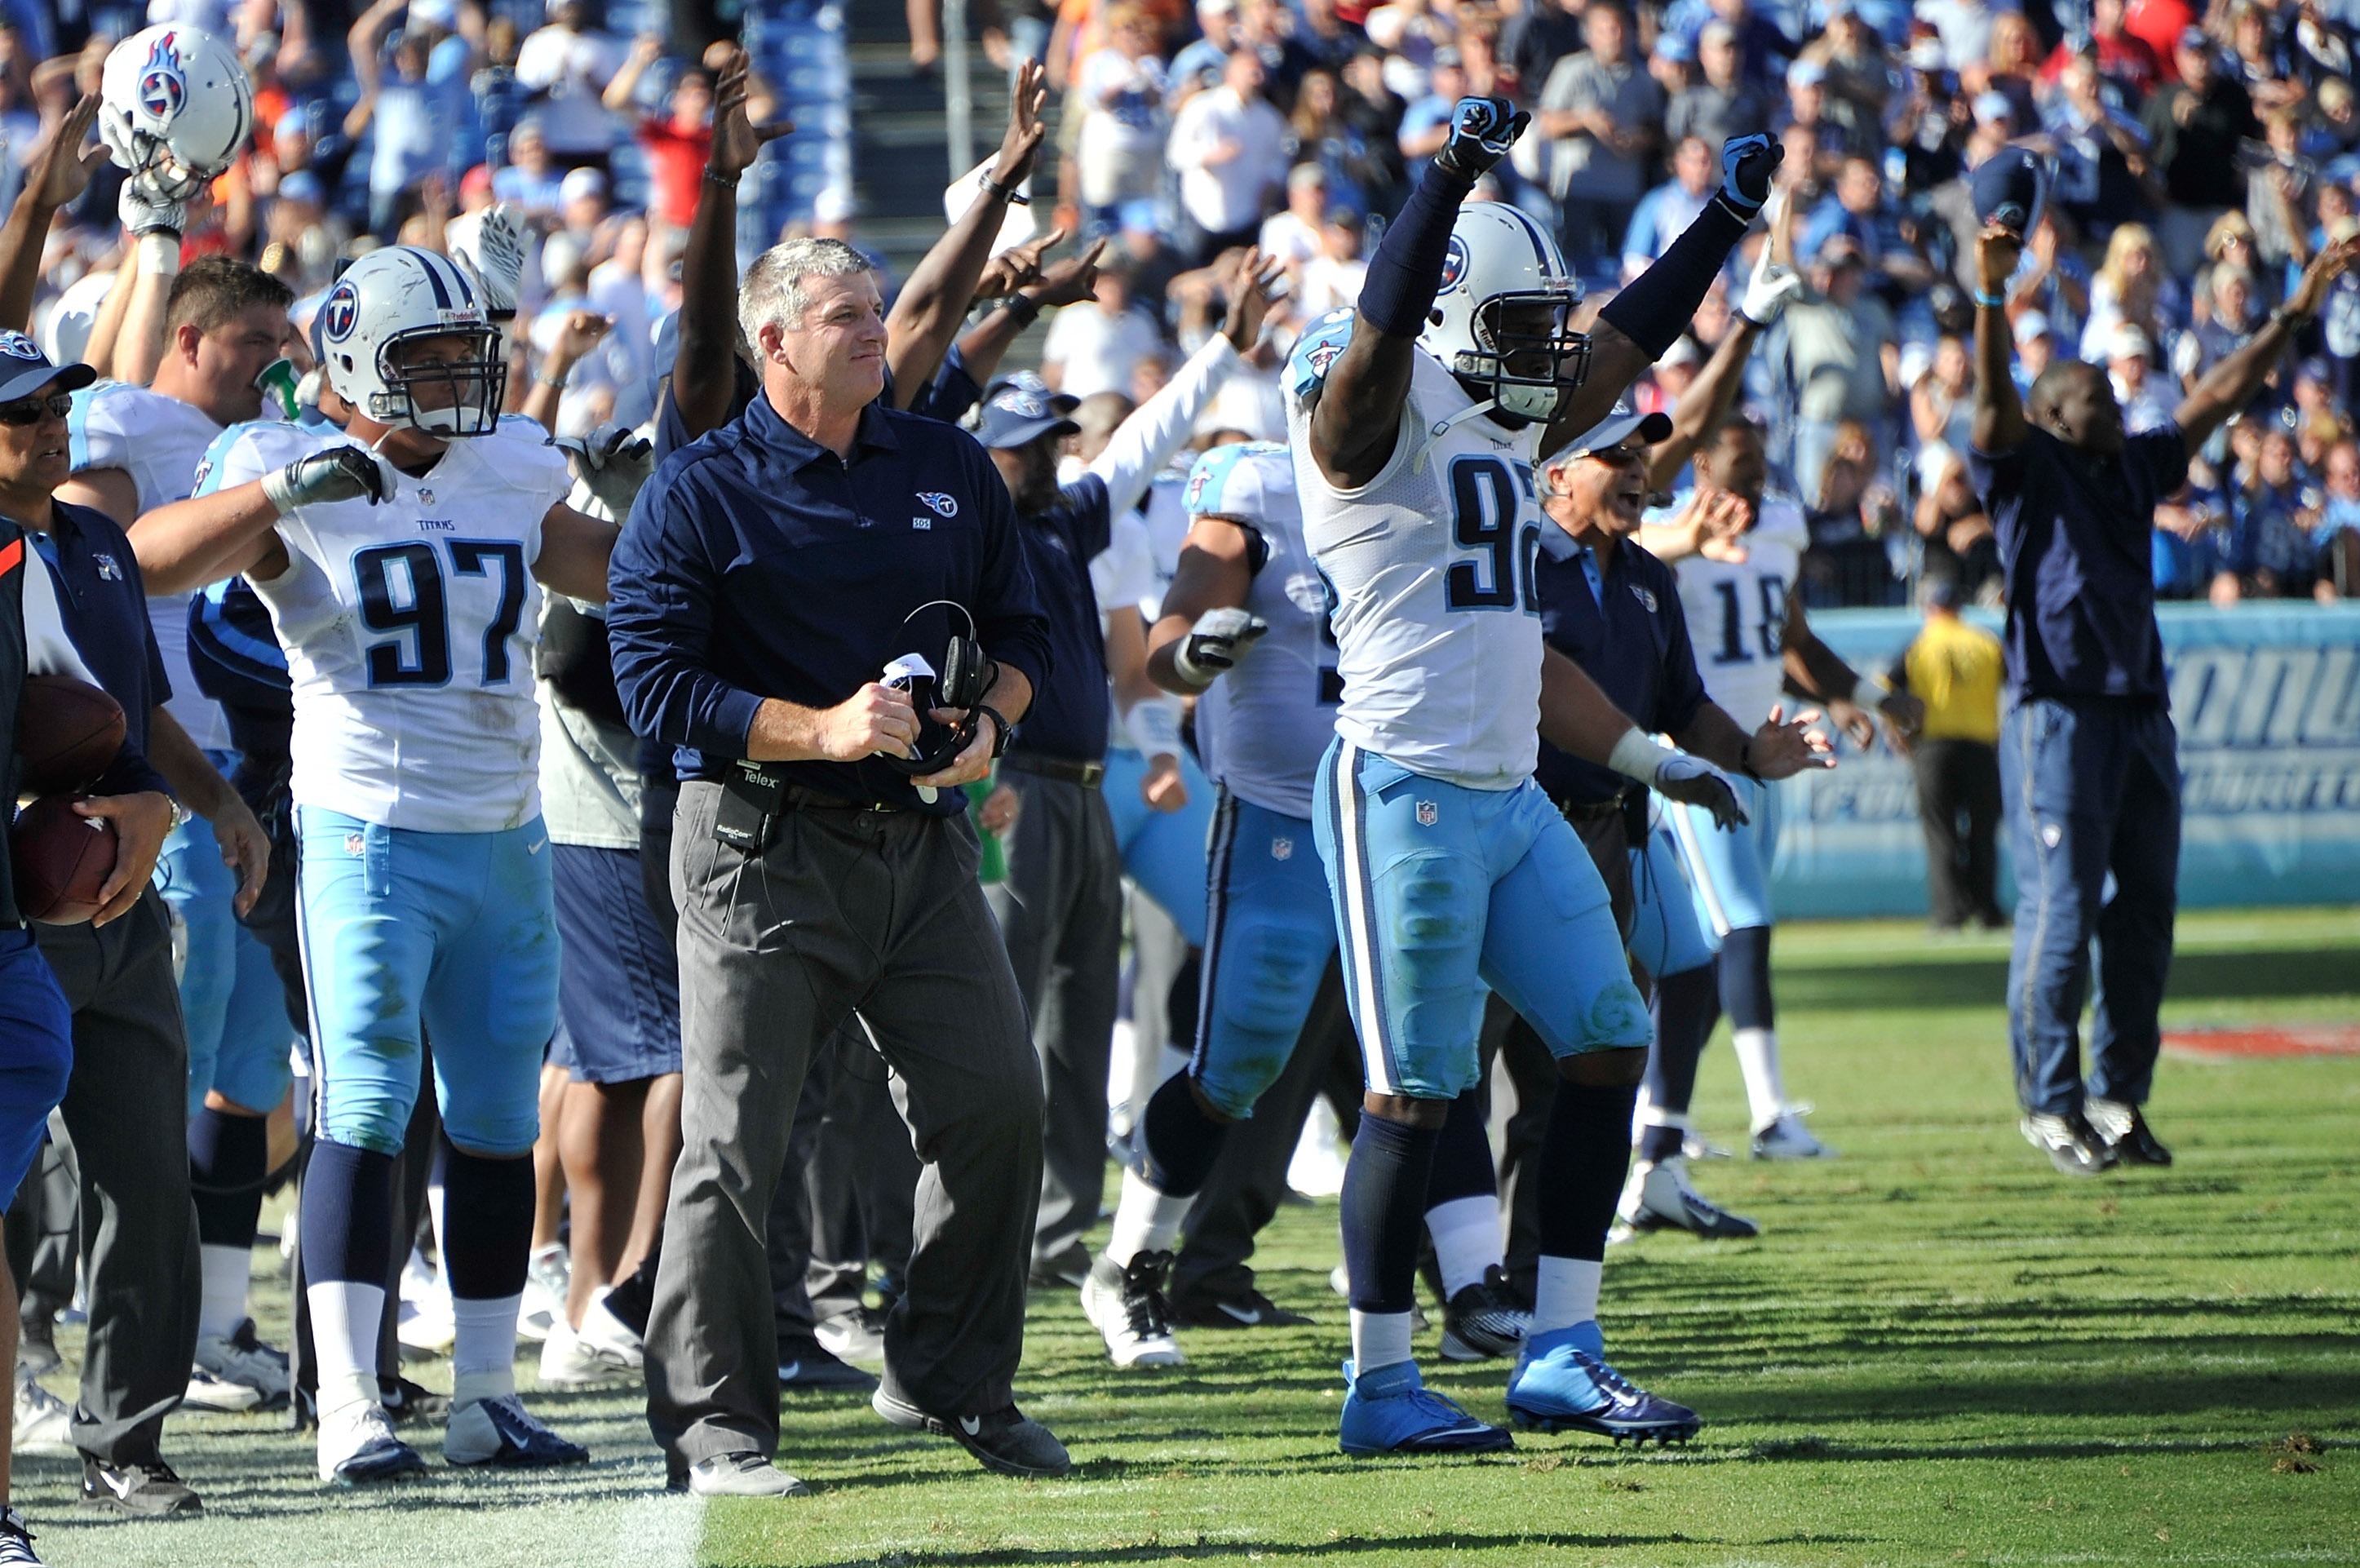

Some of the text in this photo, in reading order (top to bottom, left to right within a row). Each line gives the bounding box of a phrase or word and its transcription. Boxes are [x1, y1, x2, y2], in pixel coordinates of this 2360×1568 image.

[415, 520, 455, 531] TITANS
[349, 537, 529, 690] 97
[743, 768, 776, 789] Telex
